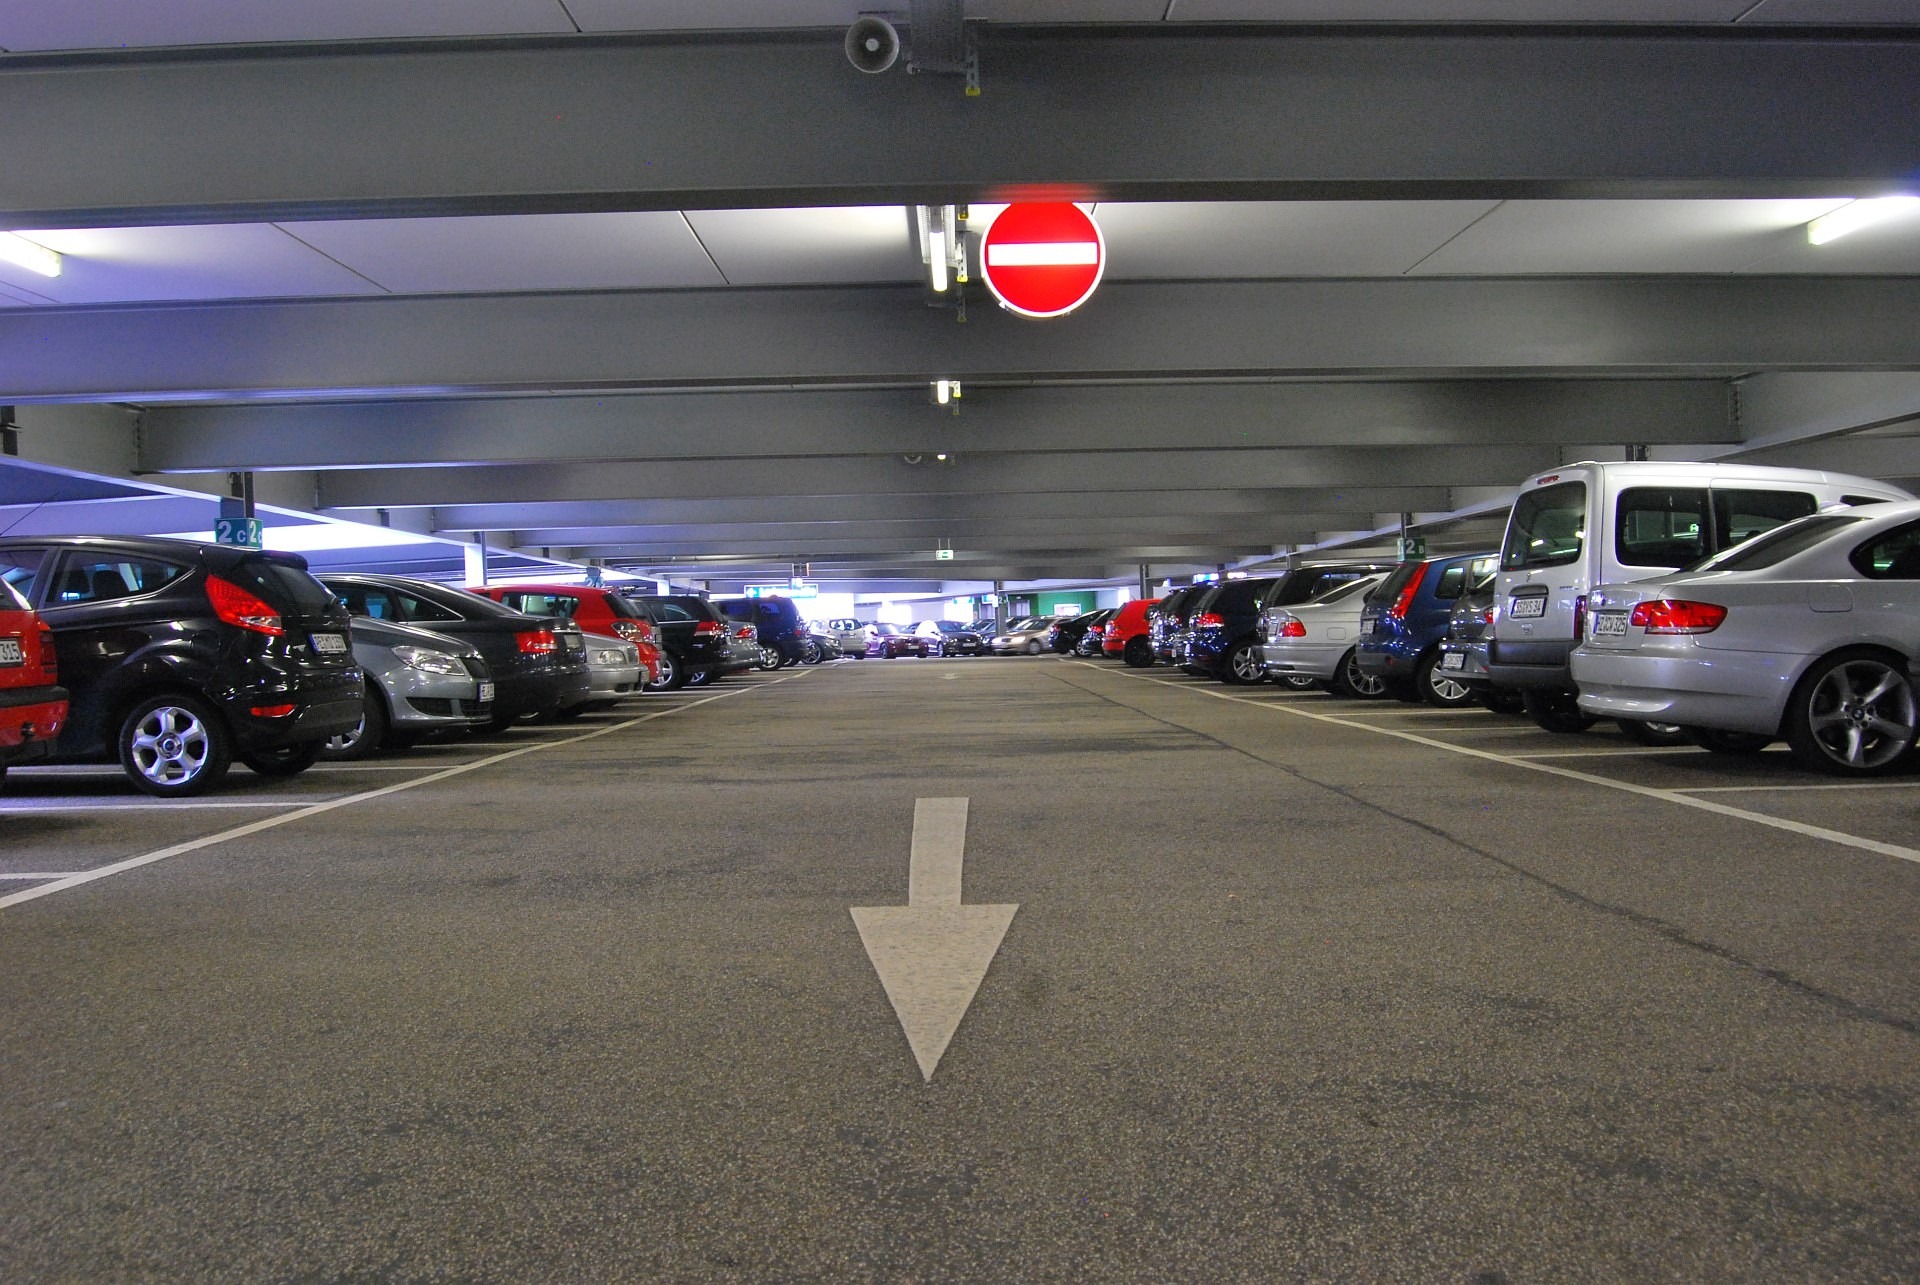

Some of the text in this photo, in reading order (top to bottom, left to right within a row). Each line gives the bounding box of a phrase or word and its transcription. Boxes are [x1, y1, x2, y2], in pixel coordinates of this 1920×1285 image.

[218, 521, 232, 543] 2
[250, 520, 257, 543] 2
[1406, 540, 1416, 554] 2
[1614, 617, 1627, 633] 325
